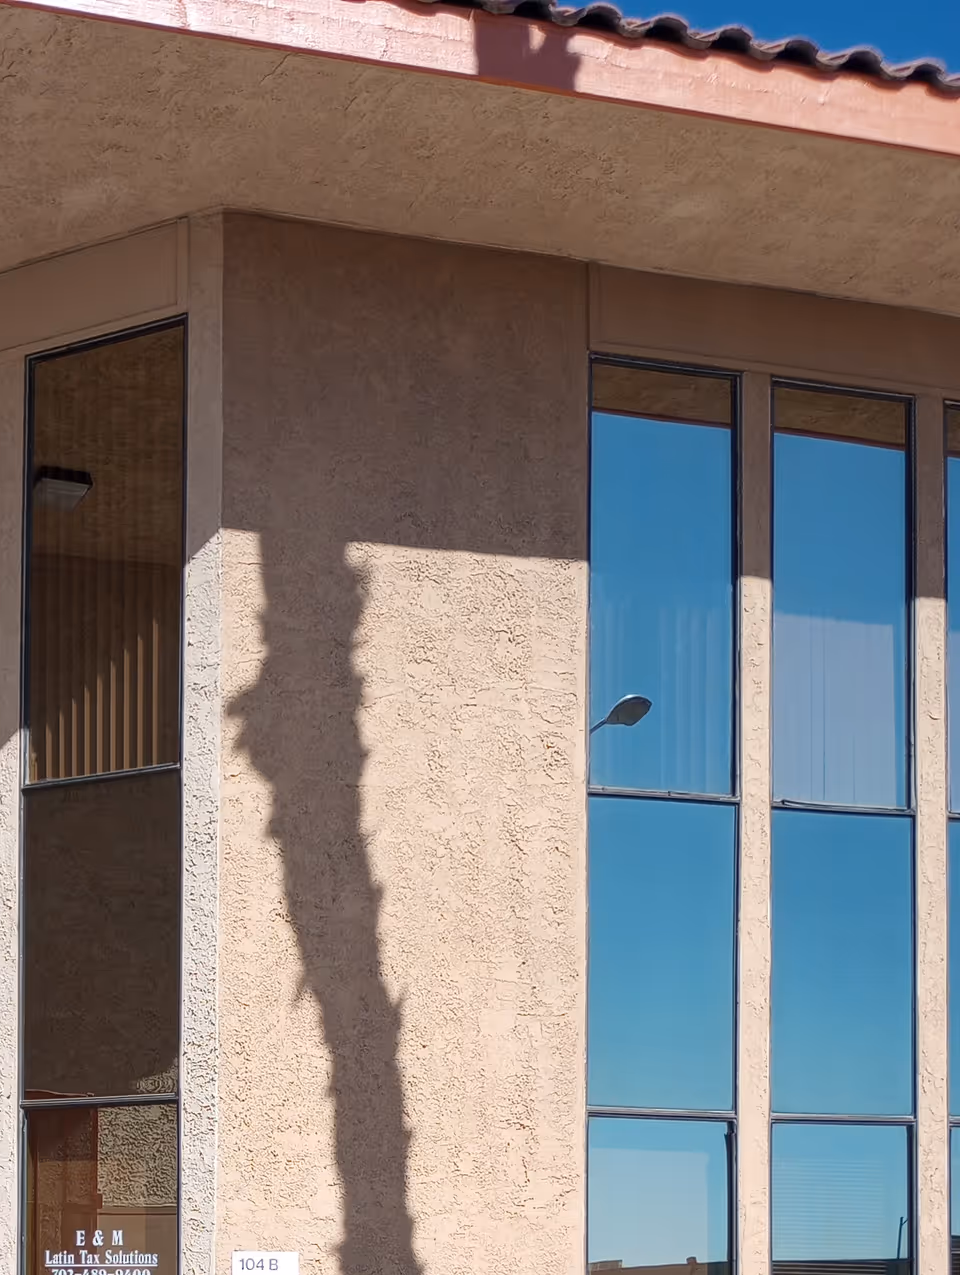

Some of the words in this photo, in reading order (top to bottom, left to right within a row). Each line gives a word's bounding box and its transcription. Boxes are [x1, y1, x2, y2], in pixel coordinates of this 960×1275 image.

[76, 1230, 85, 1246] E
[92, 1229, 104, 1246] &
[112, 1230, 123, 1246] M
[45, 1250, 74, 1265] Latin
[80, 1250, 100, 1264] Tax
[105, 1250, 158, 1264] Solutions
[239, 1258, 264, 1270] 104
[269, 1258, 278, 1270] B
